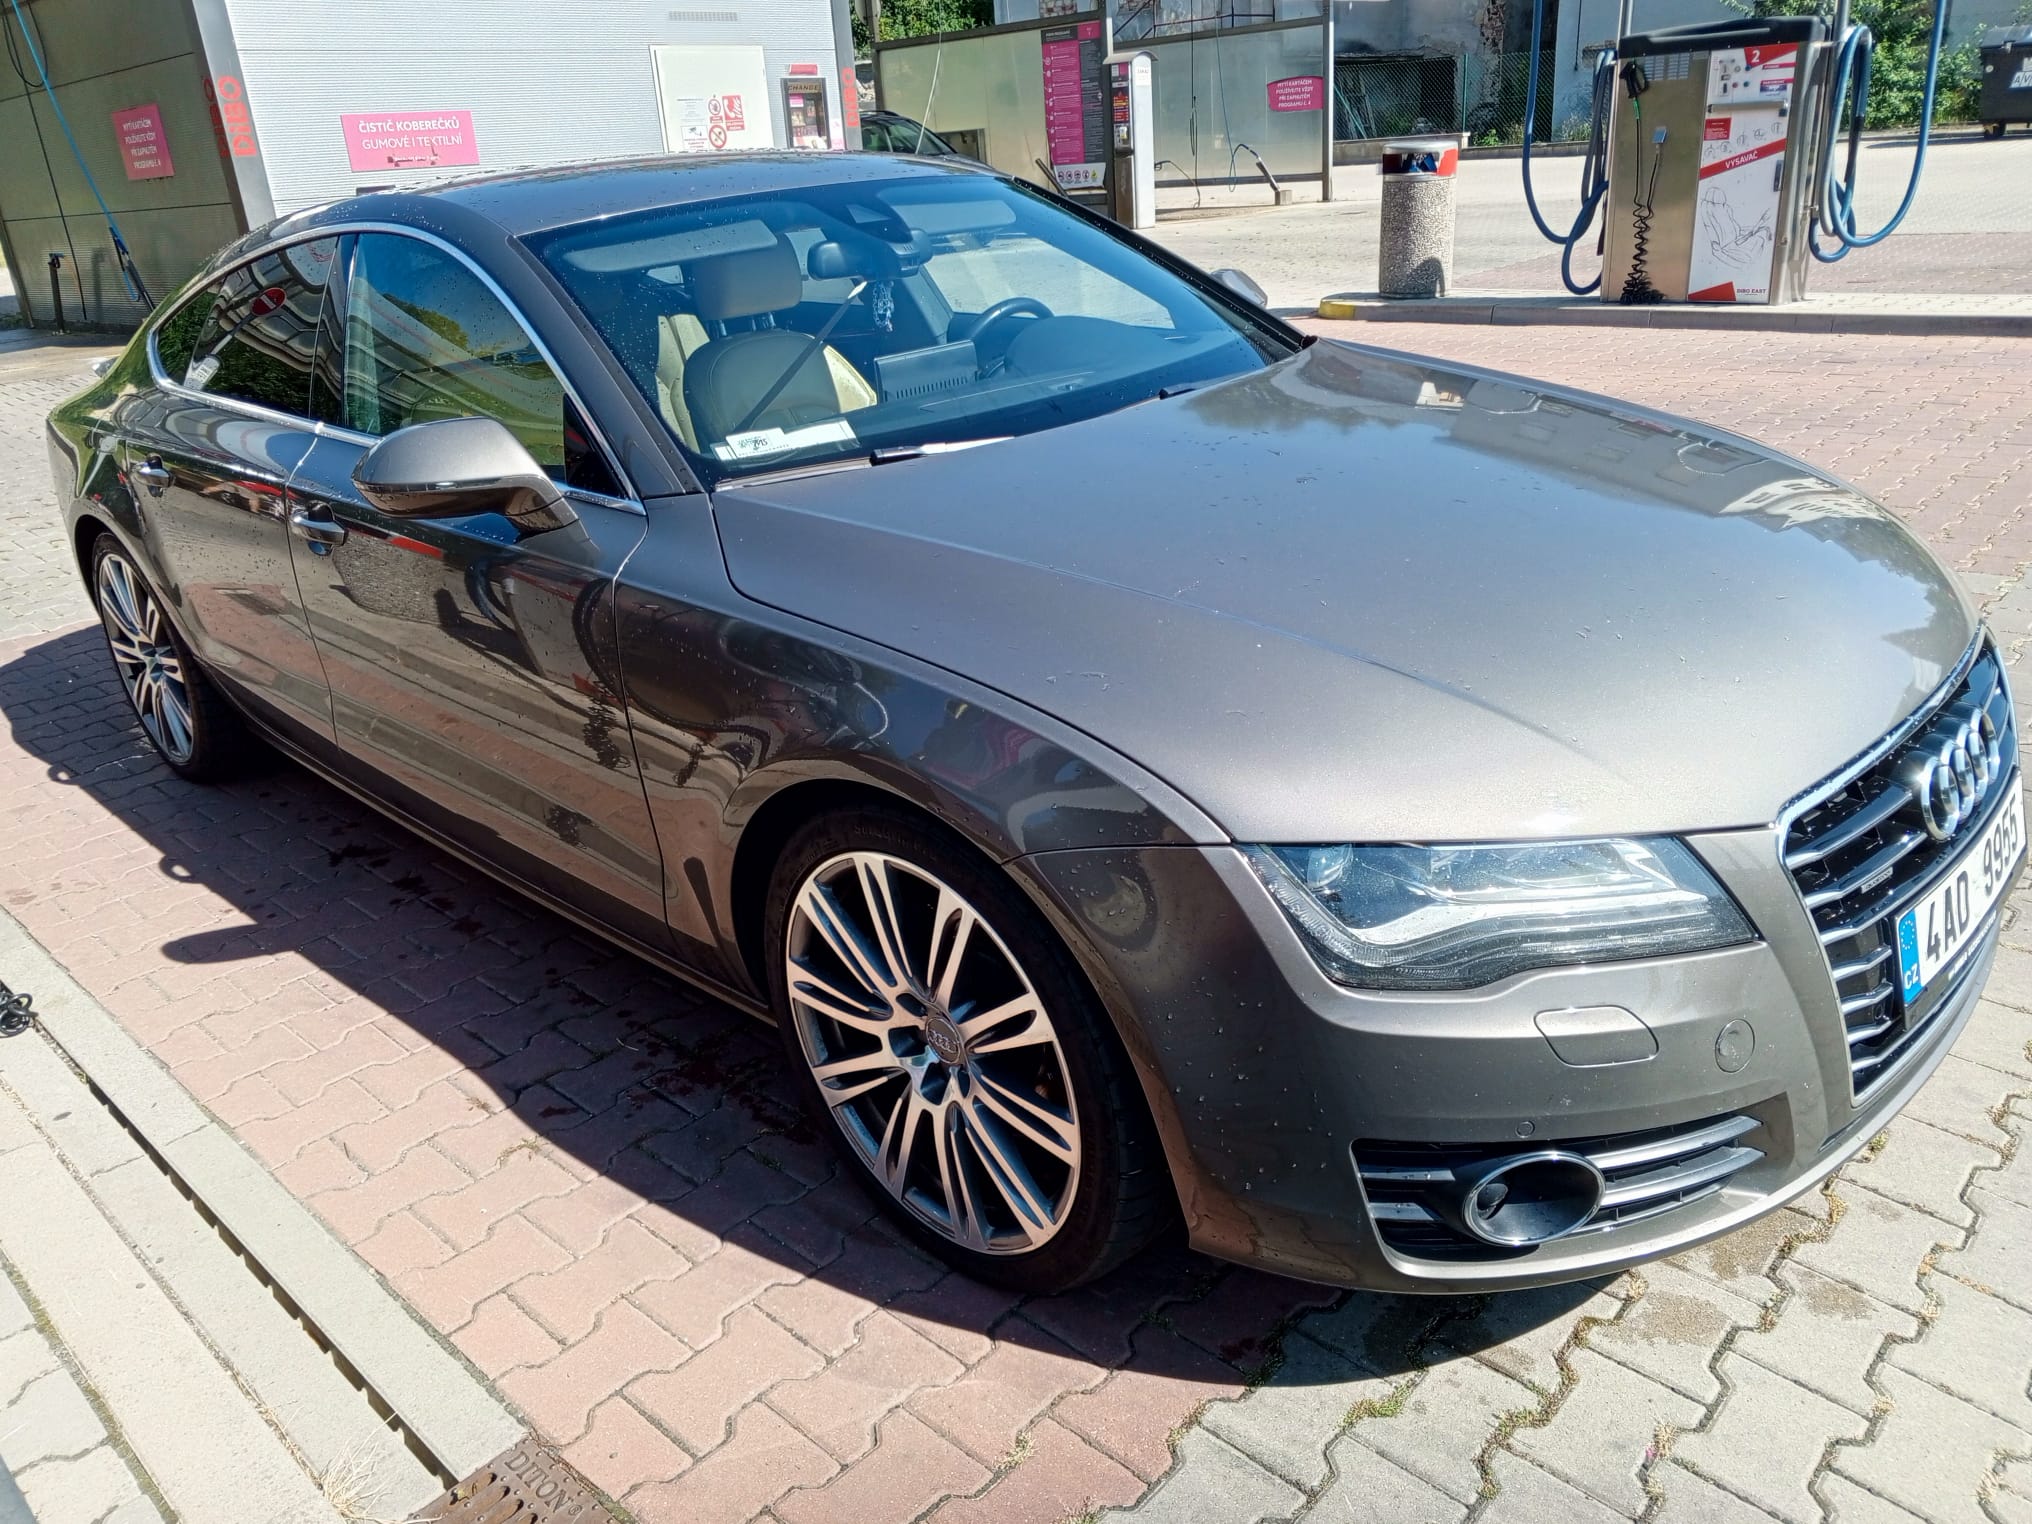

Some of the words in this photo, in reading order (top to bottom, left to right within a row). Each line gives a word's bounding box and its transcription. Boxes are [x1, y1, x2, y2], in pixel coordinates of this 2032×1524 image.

[1751, 49, 1760, 63] 2
[359, 120, 394, 133] ČISTIČ
[396, 116, 459, 131] KOBEREČKŮ
[362, 135, 411, 150] GUMOVÉ
[416, 133, 462, 147] TEXTILNÍ
[1926, 870, 1970, 963] 4AD
[1983, 793, 2018, 896] 9955
[1904, 963, 1919, 990] CZ
